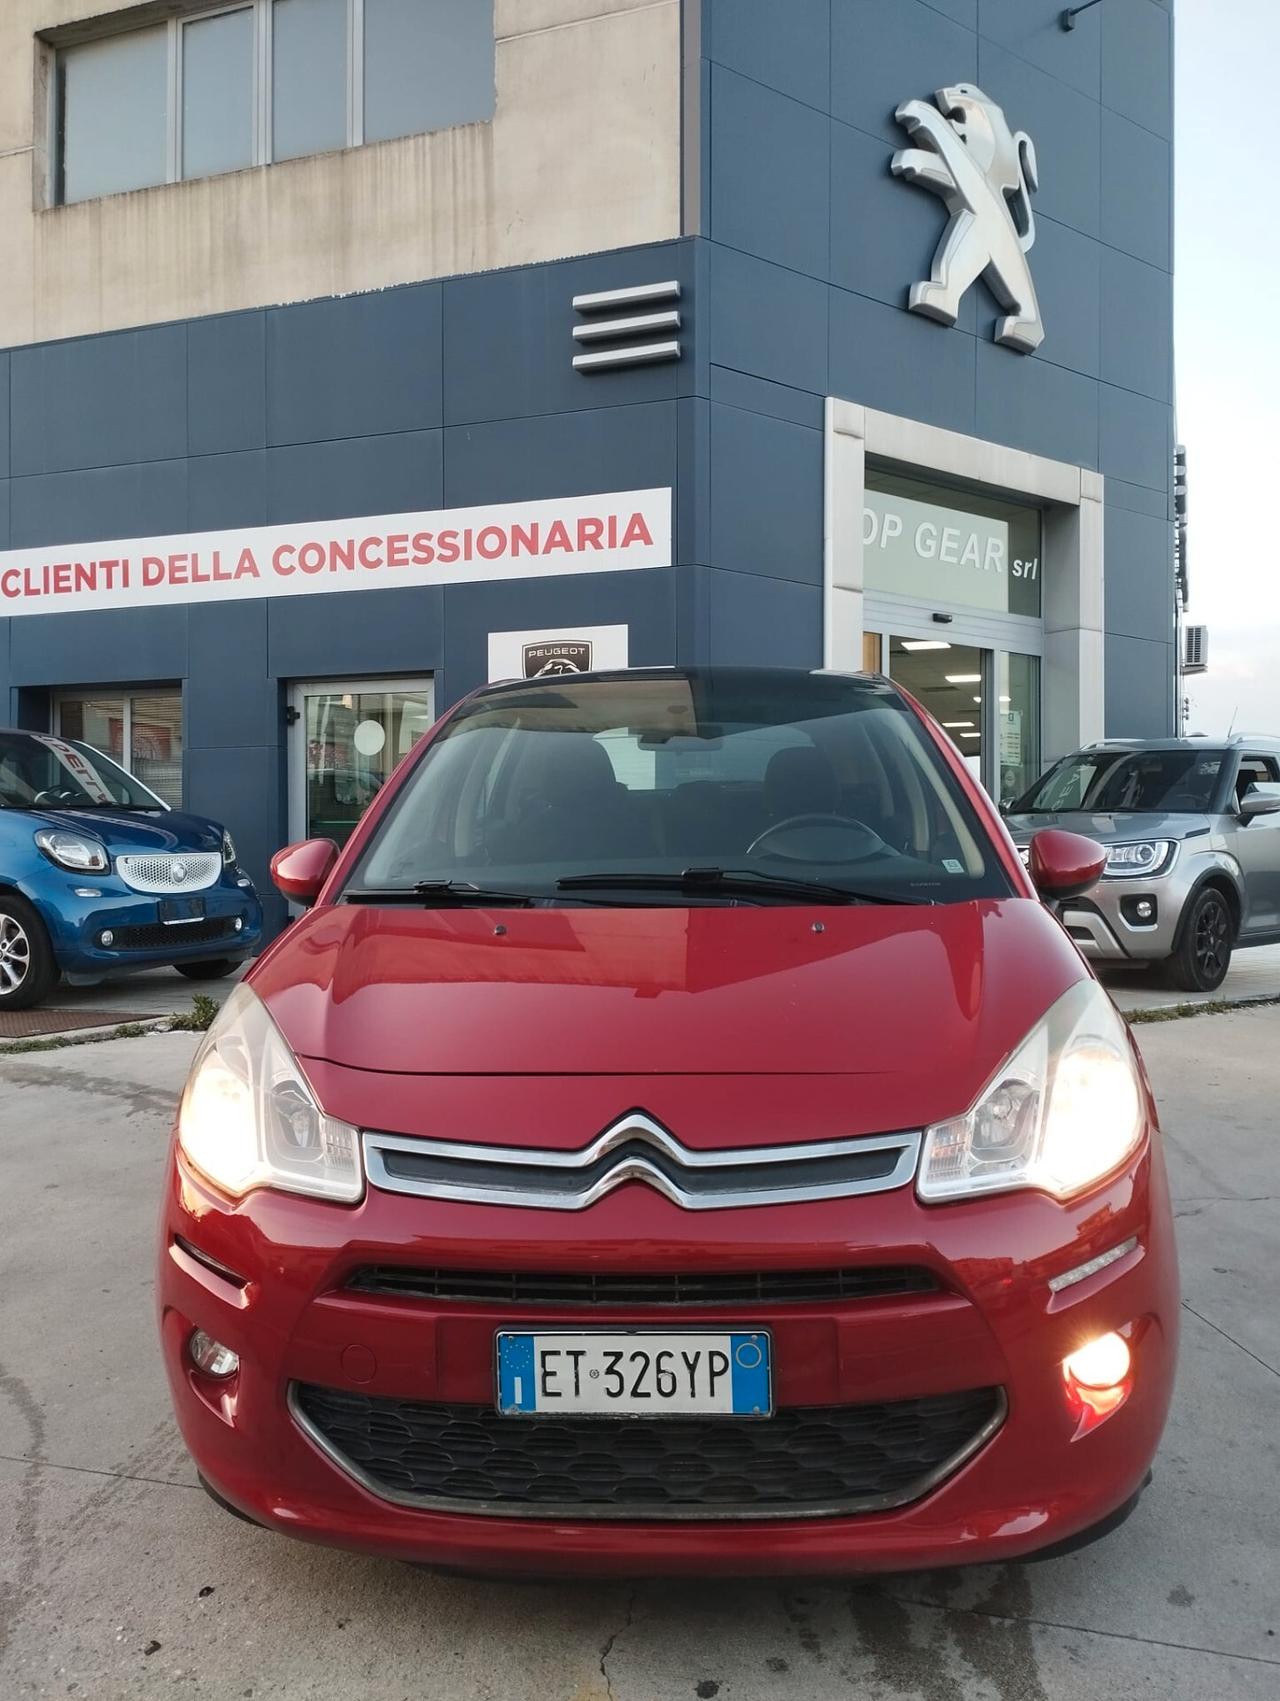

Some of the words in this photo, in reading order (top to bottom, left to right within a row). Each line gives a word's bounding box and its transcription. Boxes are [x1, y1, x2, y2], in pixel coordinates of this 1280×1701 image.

[1, 558, 130, 599] CLIENTI
[142, 547, 261, 587] DELLA
[272, 512, 653, 576] CONCESSIONARIA
[914, 521, 1005, 573] GEAR
[1012, 558, 1038, 580] srl
[528, 647, 586, 658] PEUGEOT
[540, 1350, 586, 1398] ET
[602, 1350, 730, 1399] 326YP
